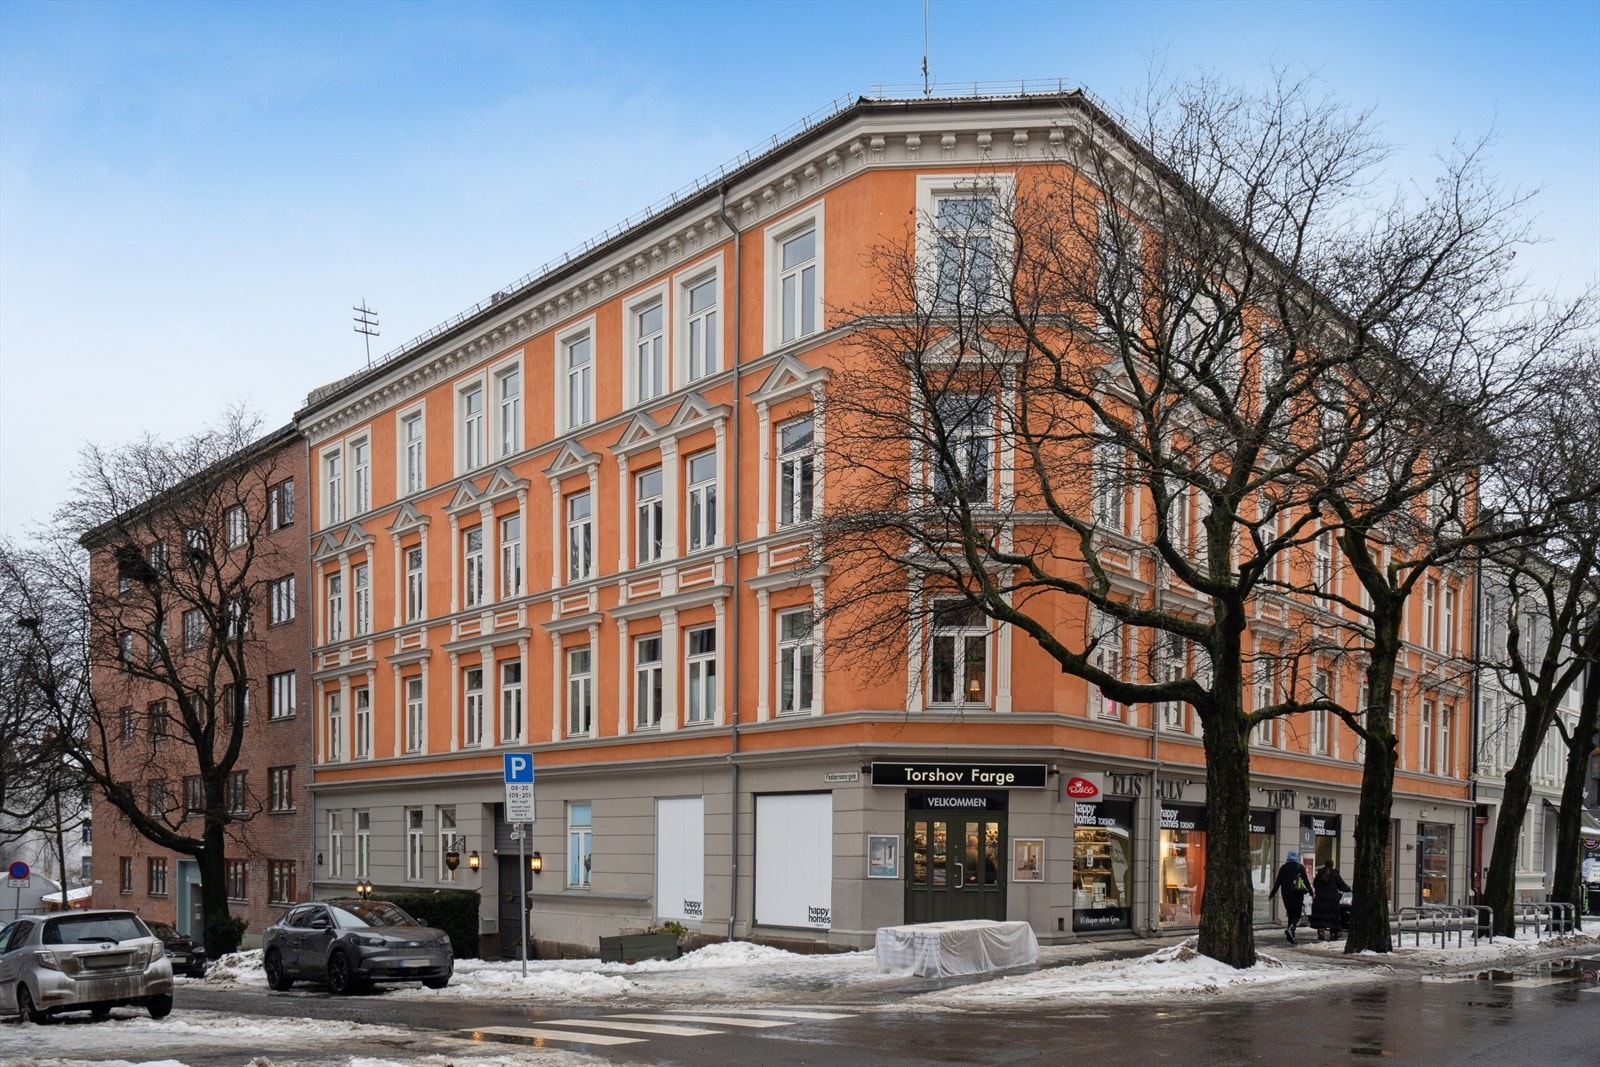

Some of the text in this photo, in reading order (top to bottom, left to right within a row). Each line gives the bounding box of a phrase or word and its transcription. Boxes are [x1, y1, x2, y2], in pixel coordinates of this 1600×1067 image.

[511, 757, 527, 780] P
[904, 767, 1015, 786] Torshov Farge
[1111, 775, 1142, 797] FLIS
[927, 797, 987, 808] VELKOMMEN
[1267, 790, 1297, 809] TAPET
[1074, 801, 1096, 816] happy
[1074, 813, 1096, 825] homes
[684, 899, 702, 909] happy
[684, 907, 703, 916] homes
[808, 905, 830, 917] happy
[808, 914, 831, 924] homes
